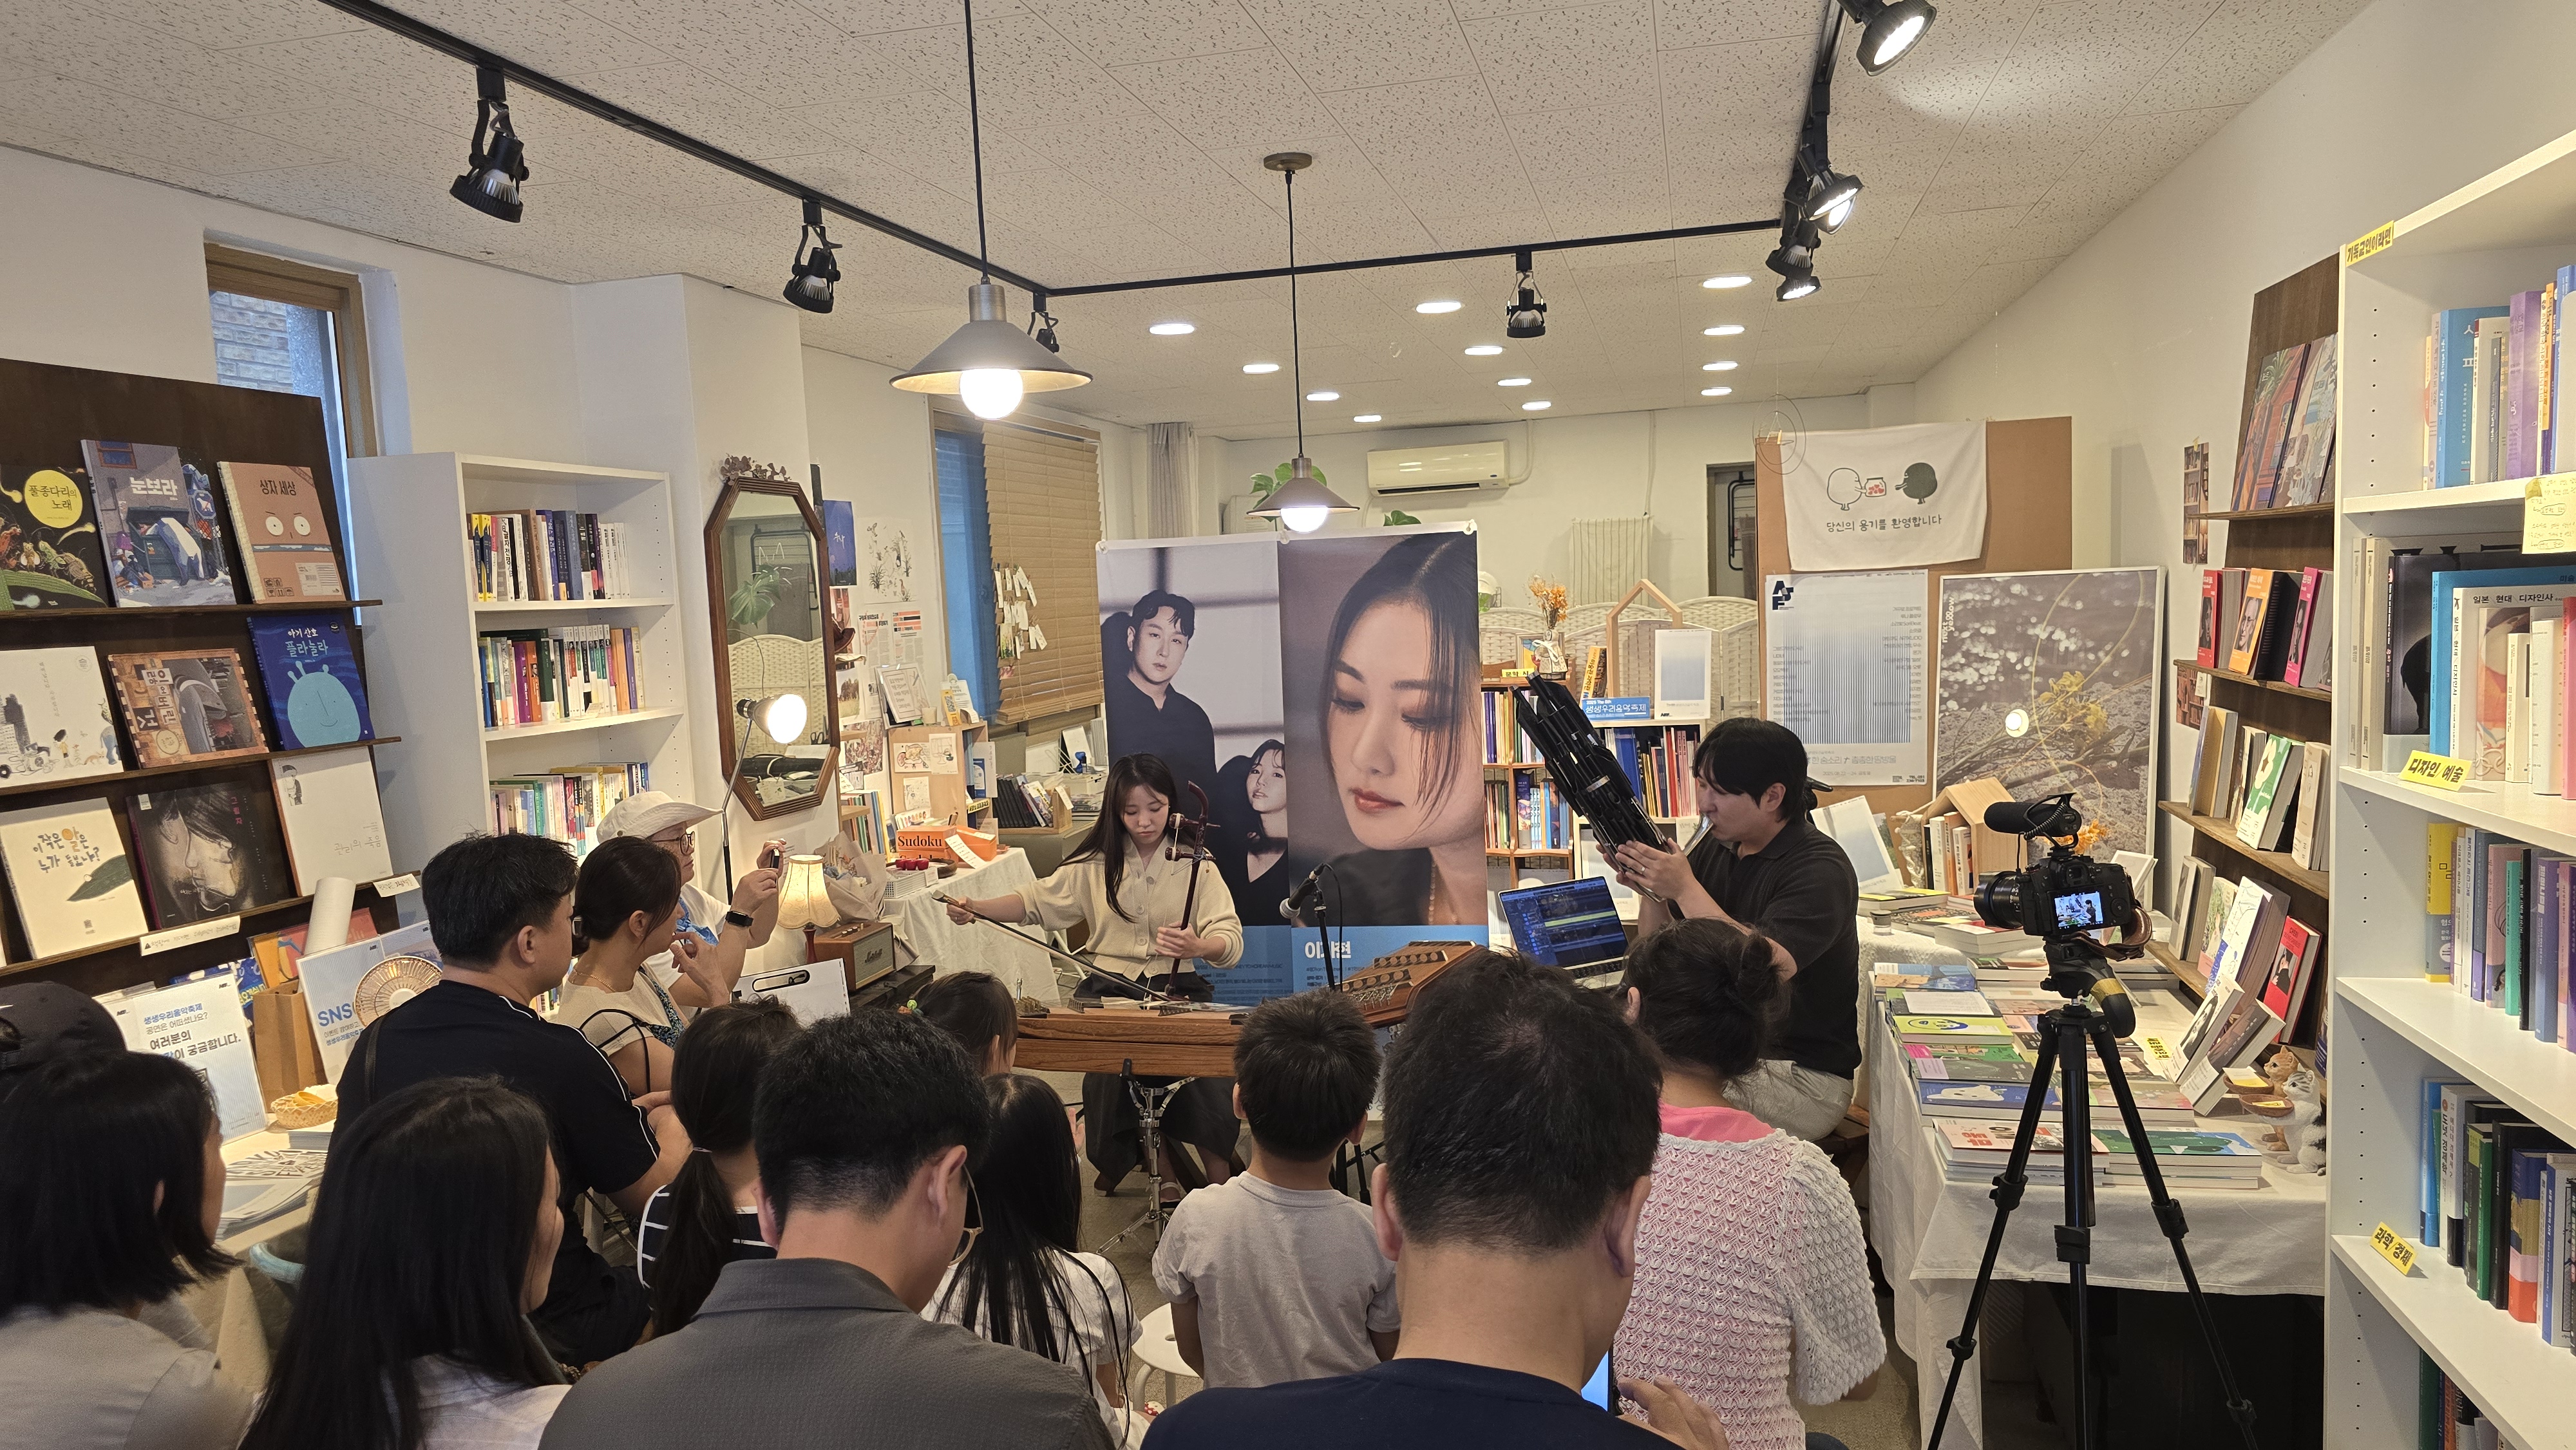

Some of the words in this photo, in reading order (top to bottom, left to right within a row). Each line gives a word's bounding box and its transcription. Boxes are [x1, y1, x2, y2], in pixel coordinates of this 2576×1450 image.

[2346, 226, 2391, 263] 기독교인이라면
[28, 484, 77, 499] 풀종다리의
[129, 476, 178, 496] 눈보라
[260, 480, 278, 495] 상자
[279, 480, 297, 496] 세상
[52, 499, 73, 511] 노래
[1826, 519, 1855, 533] 당신의
[1859, 518, 1887, 532] 용기를
[1891, 513, 1943, 530] 환영합니다
[2472, 595, 2490, 604] 일본
[2496, 594, 2512, 603] 현대
[2519, 594, 2553, 603] 디자인사
[1946, 596, 1955, 632] yellow
[287, 628, 303, 639] 아기
[304, 627, 319, 638] 산호
[2454, 616, 2459, 632] 일본
[285, 639, 329, 658] 플라눌라
[2453, 640, 2459, 656] 현대
[146, 669, 177, 724] 잃어버린
[1585, 703, 1646, 713] 생생우리음악축제
[136, 709, 159, 729] 것
[33, 842, 44, 853] 이
[37, 833, 65, 850] 작은
[61, 826, 90, 852] 알은
[334, 839, 363, 856] 관리의
[365, 835, 381, 848] 죽음
[898, 835, 942, 847] Sudoku
[38, 854, 61, 874] 누가
[144, 1003, 204, 1025] 생생우리음악축제
[317, 1002, 353, 1028] SNS
[146, 1022, 168, 1035] 공연은
[149, 1030, 192, 1050] 여러분의
[186, 1033, 242, 1057] 궁금합니다.
